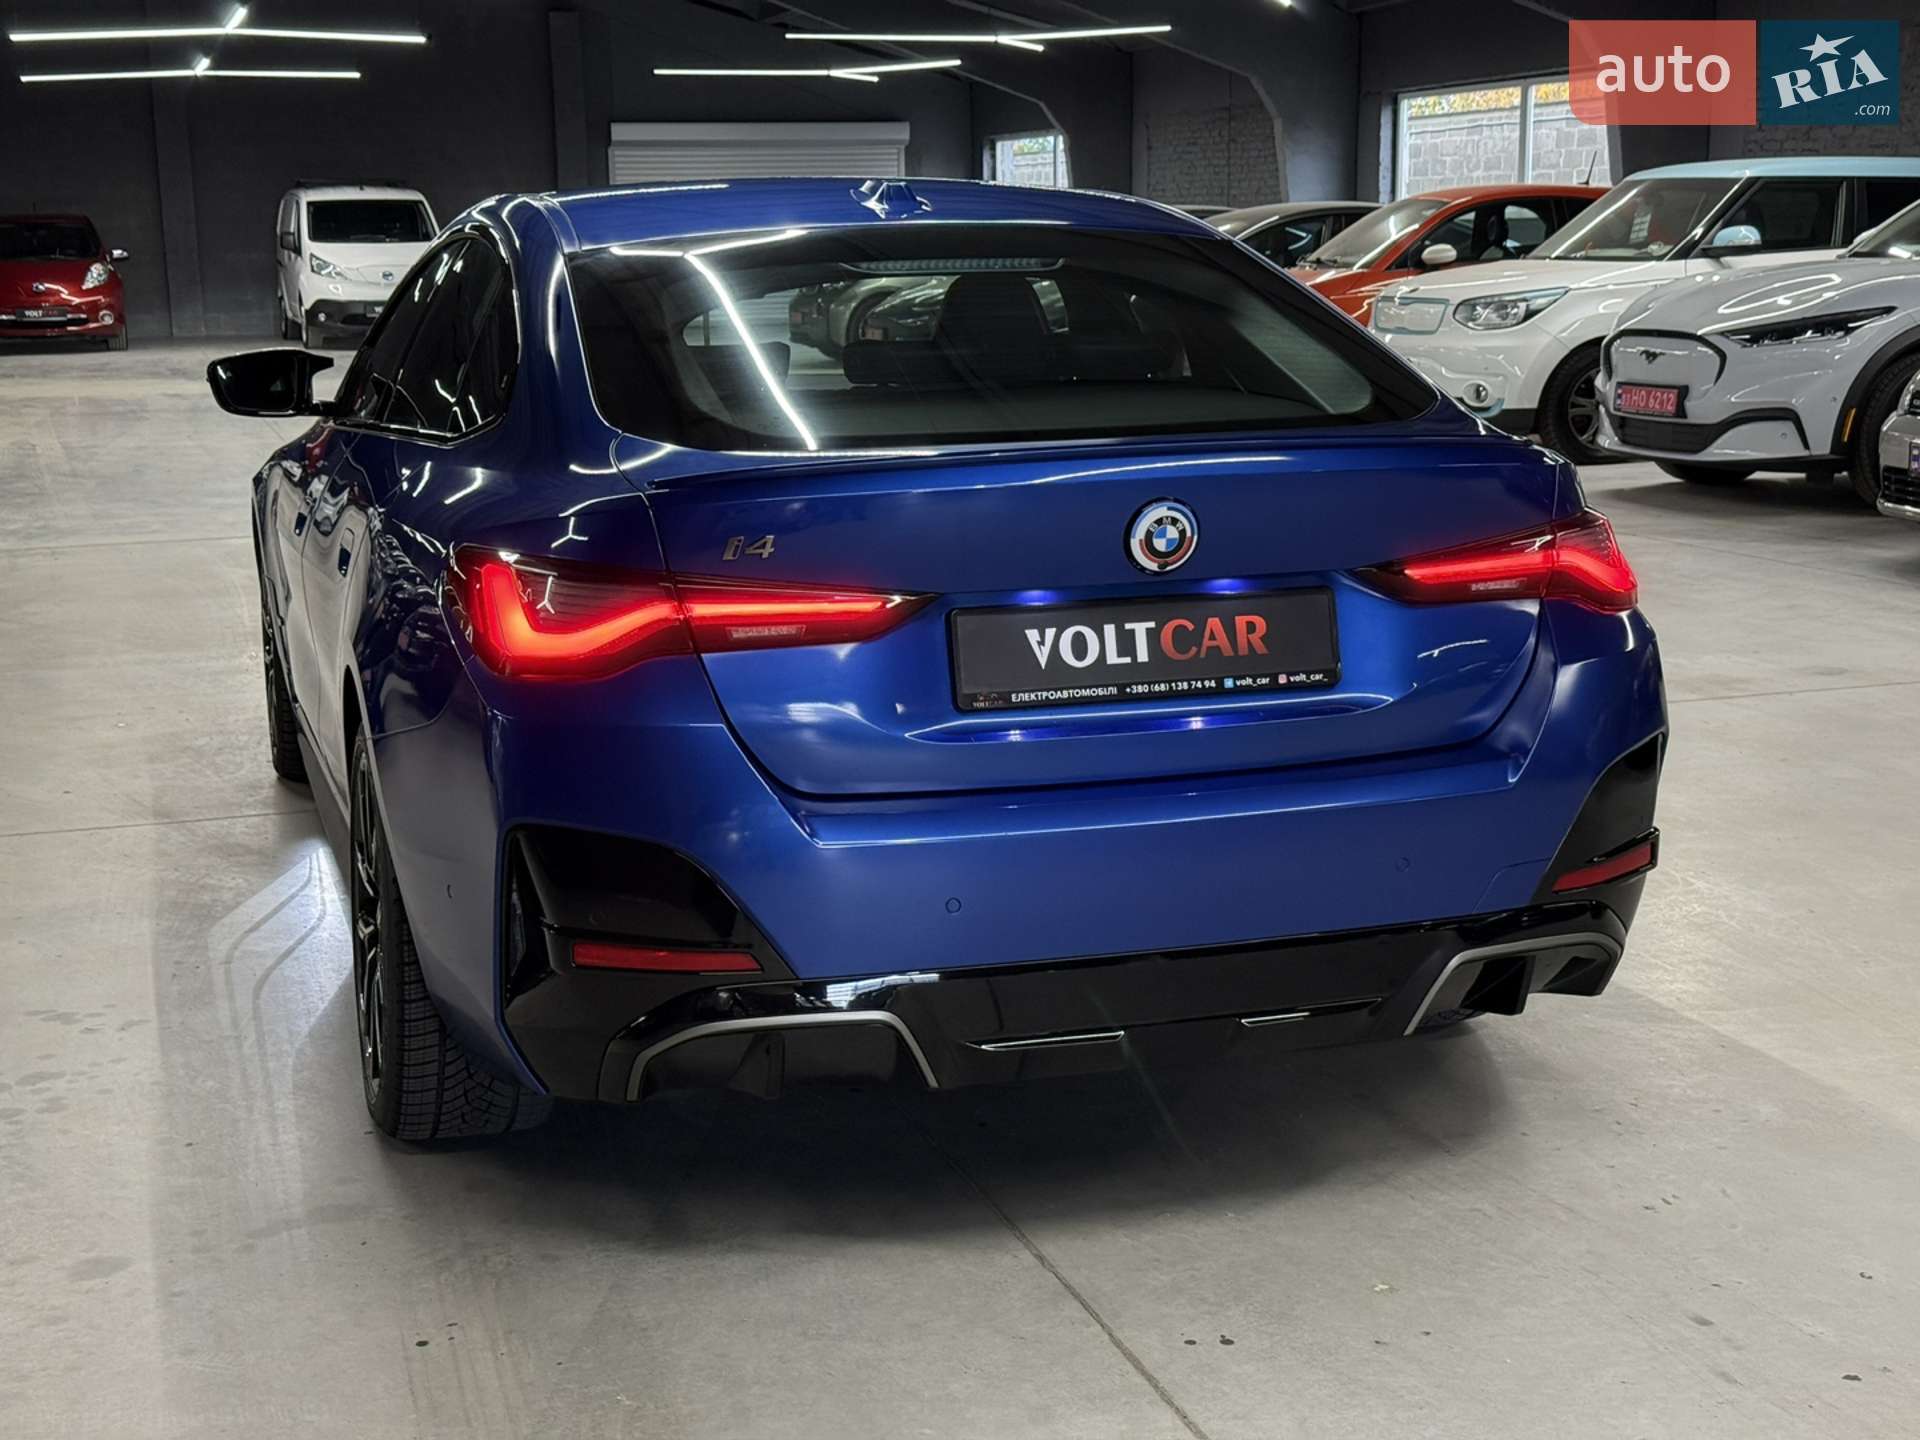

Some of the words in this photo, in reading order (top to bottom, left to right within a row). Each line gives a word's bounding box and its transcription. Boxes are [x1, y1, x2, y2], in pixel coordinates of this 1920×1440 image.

[1648, 390, 1674, 410] 6212
[1148, 516, 1185, 533] BMW
[722, 535, 775, 560] i4
[1235, 676, 1270, 687] volt_car
[1289, 672, 1329, 682] volt_car_
[1011, 686, 1118, 702] ЕЛЕКТРОАВТОМОБІЛІ
[1125, 684, 1149, 694] +380
[1150, 682, 1169, 692] (68)
[1171, 681, 1189, 691] 138
[1190, 680, 1202, 689] 74
[1203, 679, 1216, 688] 94
